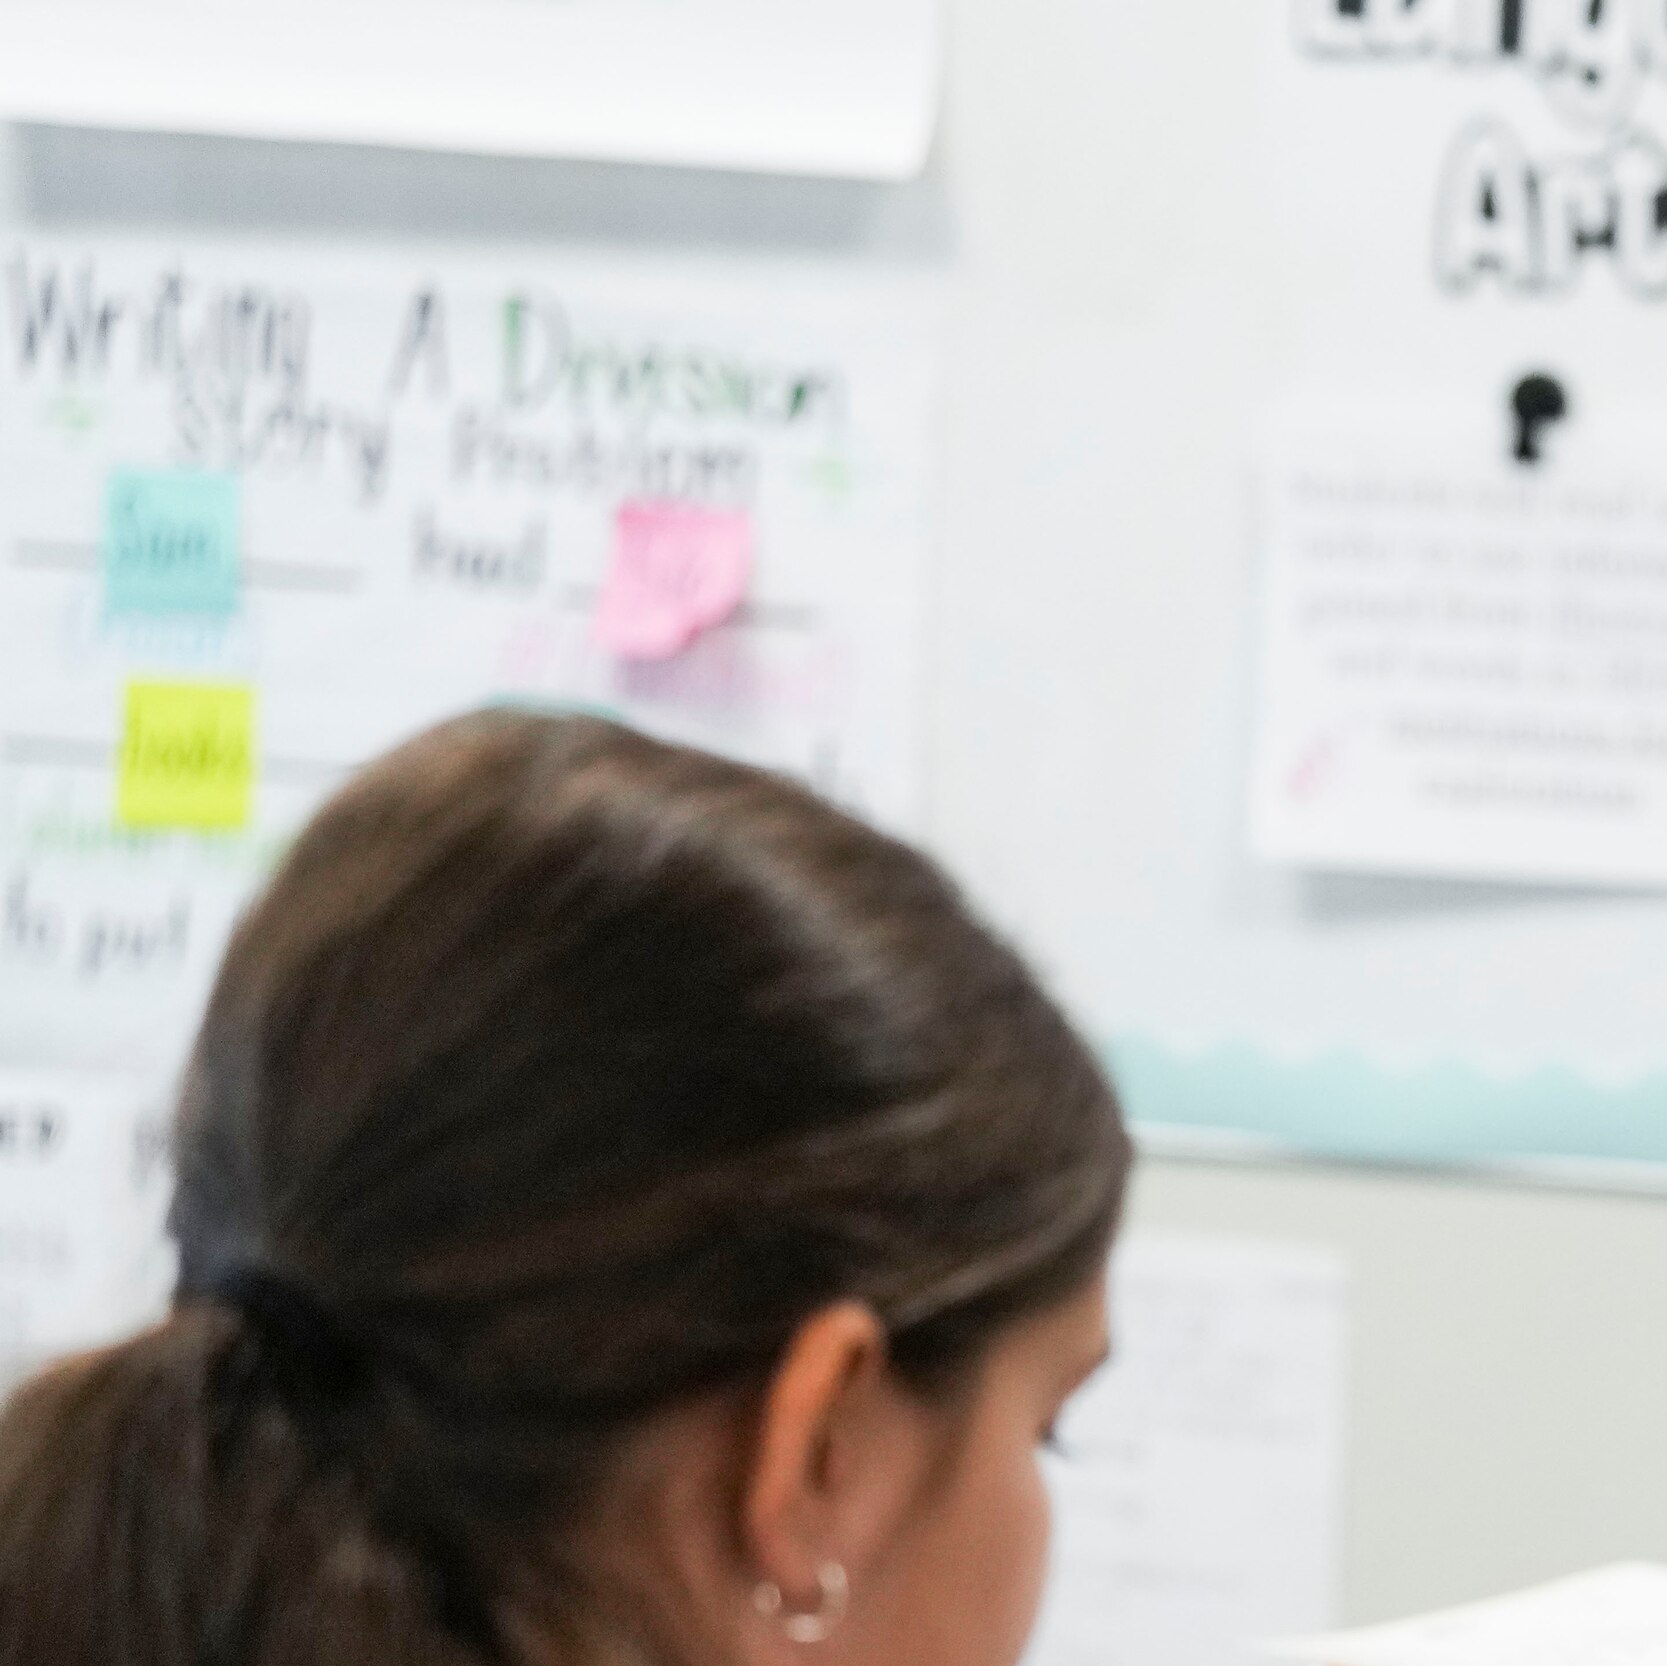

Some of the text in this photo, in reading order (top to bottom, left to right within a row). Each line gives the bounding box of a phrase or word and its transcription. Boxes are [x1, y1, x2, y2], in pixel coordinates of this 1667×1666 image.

[5, 252, 852, 428] Writing A Division
